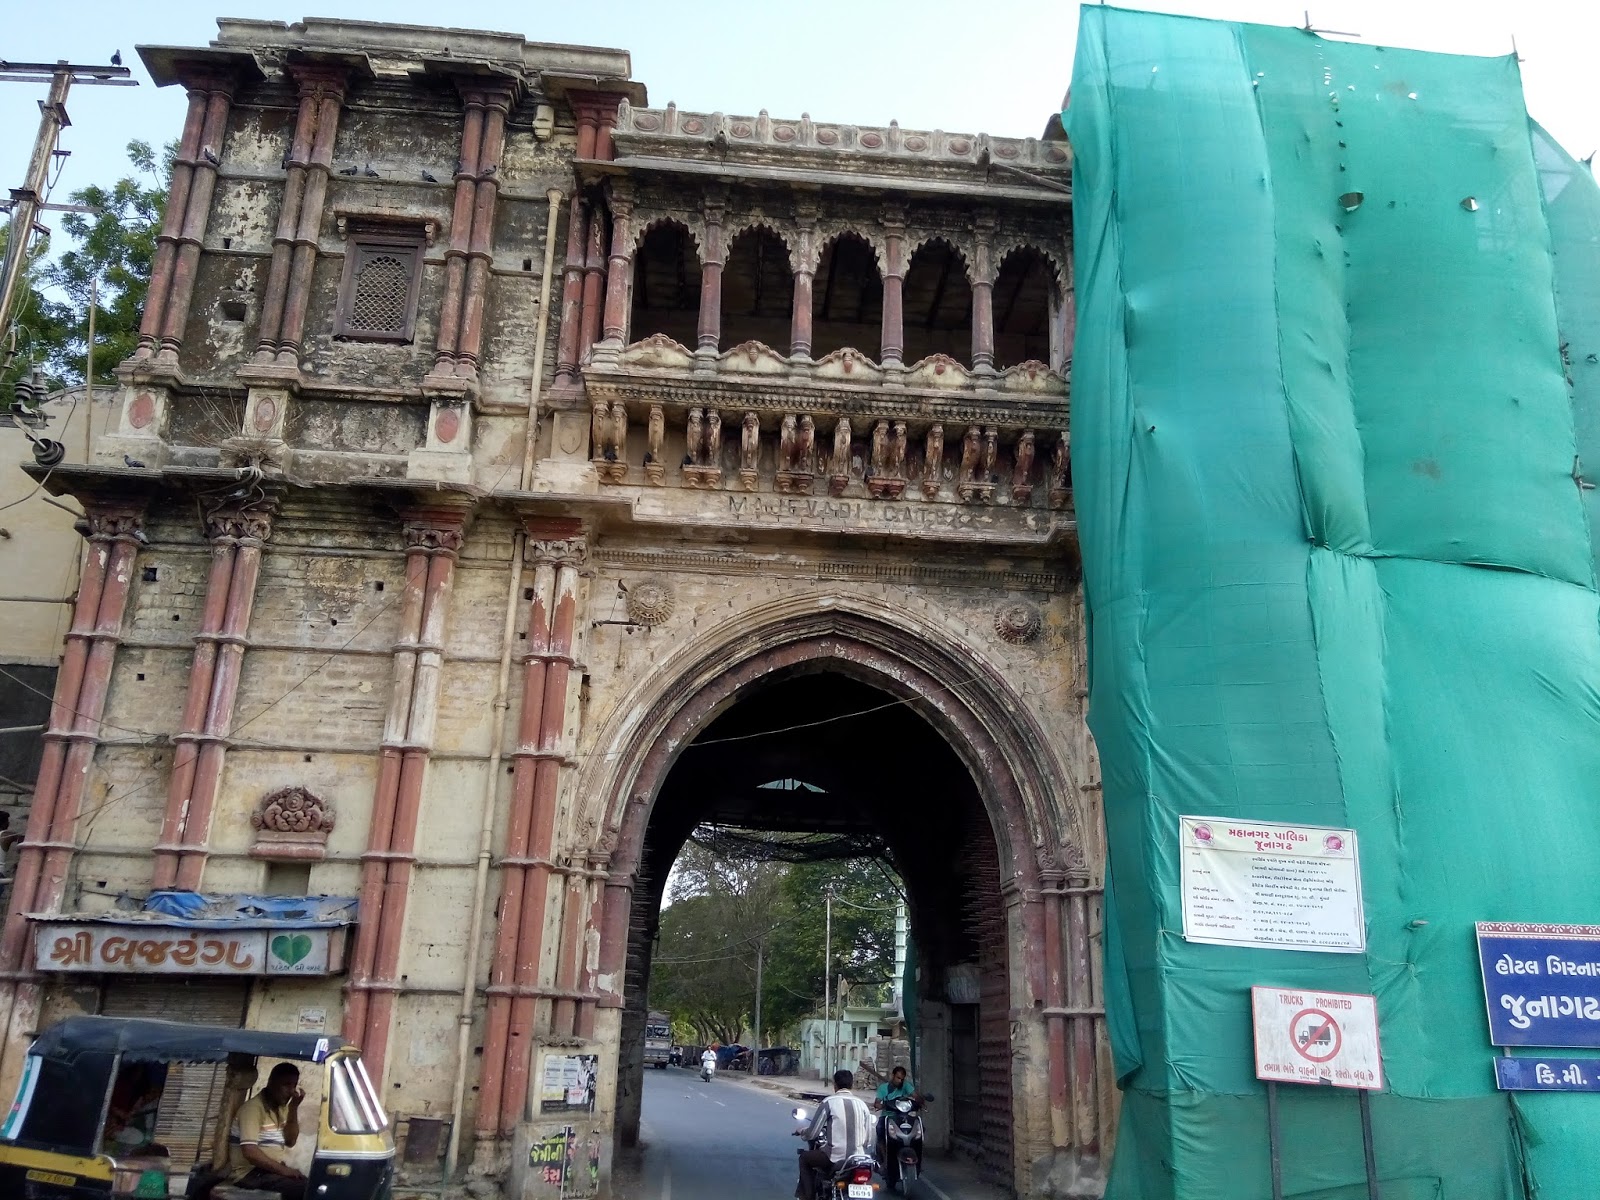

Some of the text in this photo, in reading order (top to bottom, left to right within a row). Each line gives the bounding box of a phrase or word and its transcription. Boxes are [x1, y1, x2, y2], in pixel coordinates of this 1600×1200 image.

[1228, 828, 1308, 842] મહાનગર પાલિકા
[50, 931, 93, 967] શ્રી
[1495, 953, 1539, 975] હોટલ
[1279, 994, 1352, 1010] TRUCKS PROHIBITED
